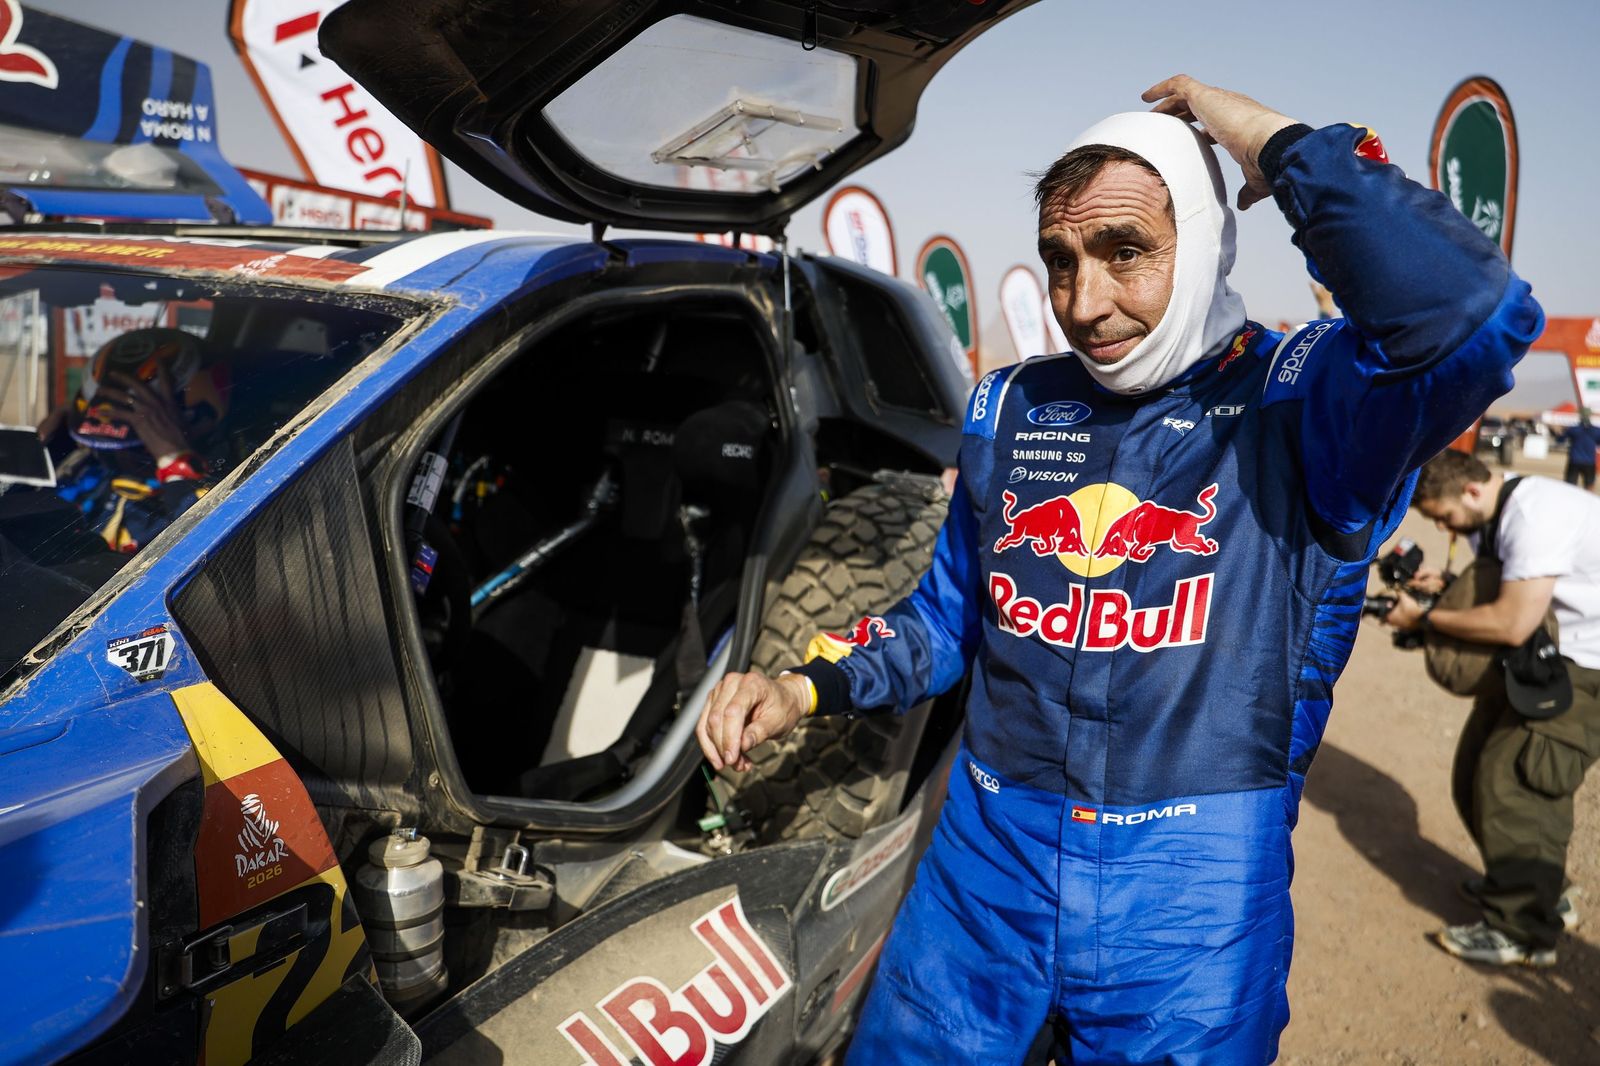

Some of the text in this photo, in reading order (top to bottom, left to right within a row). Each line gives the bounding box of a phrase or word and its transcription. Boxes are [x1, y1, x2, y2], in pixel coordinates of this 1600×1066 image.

[142, 98, 209, 121] A HARO
[140, 119, 212, 142] N ROMA
[1277, 321, 1337, 385] sparco
[1038, 404, 1080, 422] Ford
[1014, 431, 1092, 443] RACING
[1012, 449, 1086, 463] SAMSUNG SSD
[1028, 471, 1079, 483] VISION
[987, 571, 1215, 652] Red Bull
[118, 637, 166, 673] 371
[1102, 803, 1197, 826] ROMA
[234, 838, 289, 877] DAKAR
[247, 864, 283, 889] 2026
[594, 893, 794, 1066] Bull
